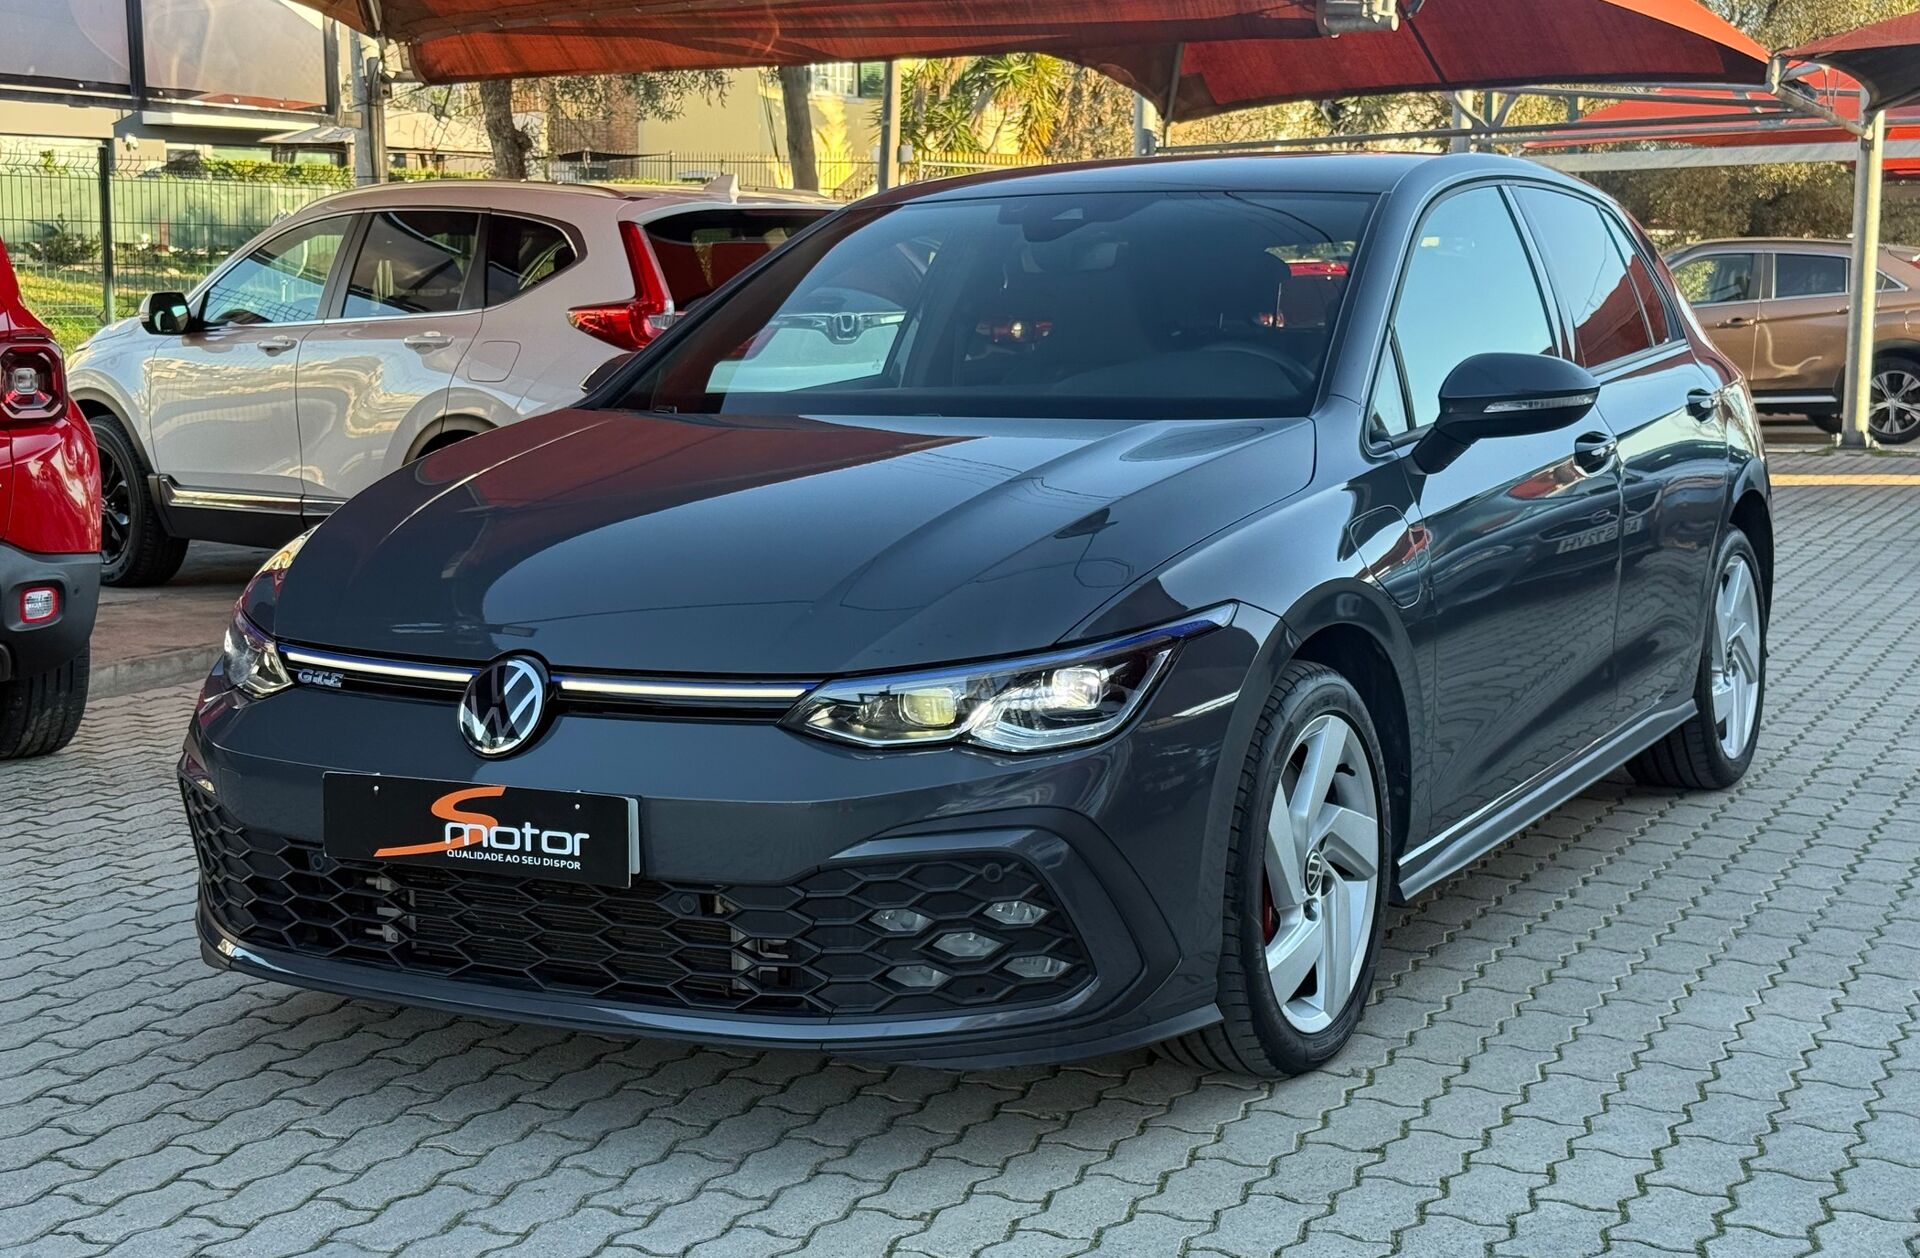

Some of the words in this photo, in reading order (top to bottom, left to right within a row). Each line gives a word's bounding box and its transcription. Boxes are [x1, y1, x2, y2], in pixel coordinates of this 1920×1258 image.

[298, 669, 344, 688] GTE
[447, 849, 504, 862] QUALIDADE
[505, 854, 520, 863] AO
[521, 855, 541, 866] SEU
[543, 858, 581, 870] DISPOR
